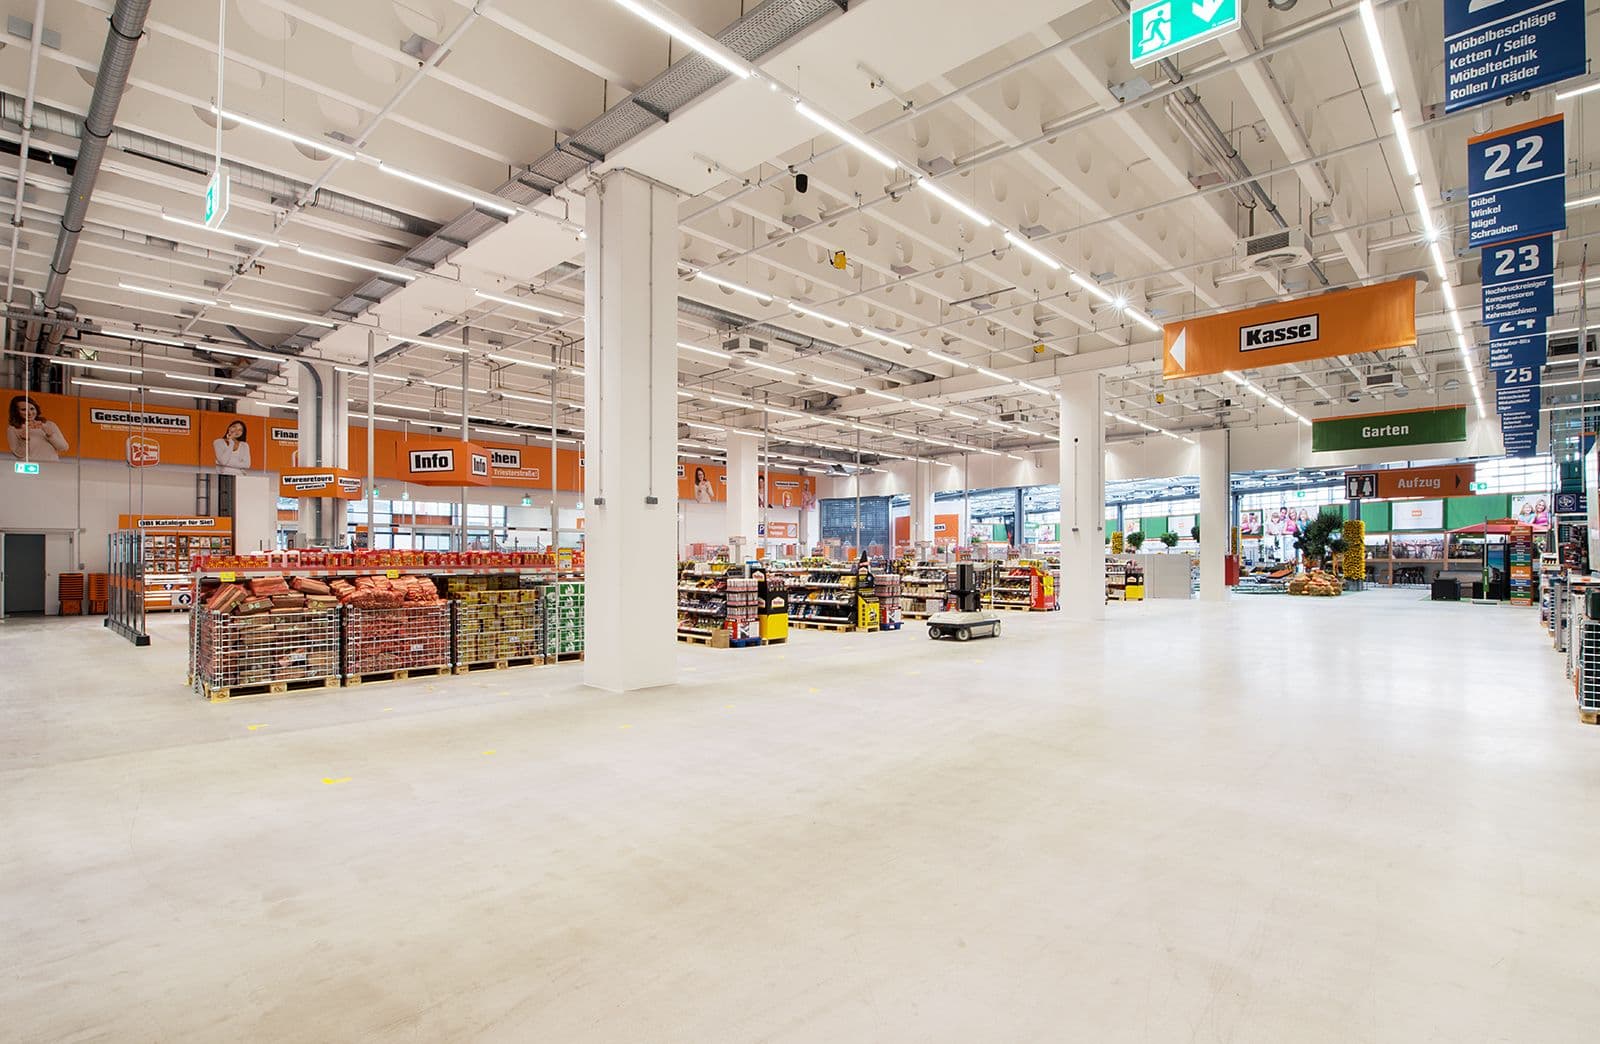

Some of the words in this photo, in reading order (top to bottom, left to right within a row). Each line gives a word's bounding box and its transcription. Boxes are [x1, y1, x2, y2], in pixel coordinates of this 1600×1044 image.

[1449, 11, 1557, 54] Möbelbeschläge
[1449, 48, 1492, 69] Ketten
[1495, 43, 1501, 56] /
[1503, 34, 1536, 52] Seile
[1450, 49, 1538, 85] Möbeltechnik
[1450, 81, 1488, 100] Rollen
[1491, 76, 1498, 89] /
[1500, 66, 1540, 86] Räder
[1484, 135, 1544, 181] 22
[1471, 195, 1496, 208] Dübel
[1471, 205, 1501, 218] Winkel
[1471, 216, 1497, 229] Nägel
[1471, 224, 1518, 240] Schrauben
[1495, 244, 1540, 277] 23
[1485, 280, 1547, 296] Hochdruckreiniger
[1485, 291, 1534, 304] Kompressoren
[1485, 301, 1520, 311] NT-Sauger
[1485, 307, 1537, 320] Kehrmaschinen
[1246, 322, 1312, 347] Kasse
[1504, 367, 1533, 384] 25
[94, 411, 187, 427] Geschenkkarte
[1362, 424, 1409, 438] Garten
[414, 453, 449, 469] Info
[473, 457, 486, 473] Info
[284, 475, 333, 483] Warenretoure
[1397, 476, 1441, 491] Aufzug
[155, 519, 187, 527] Kataloge
